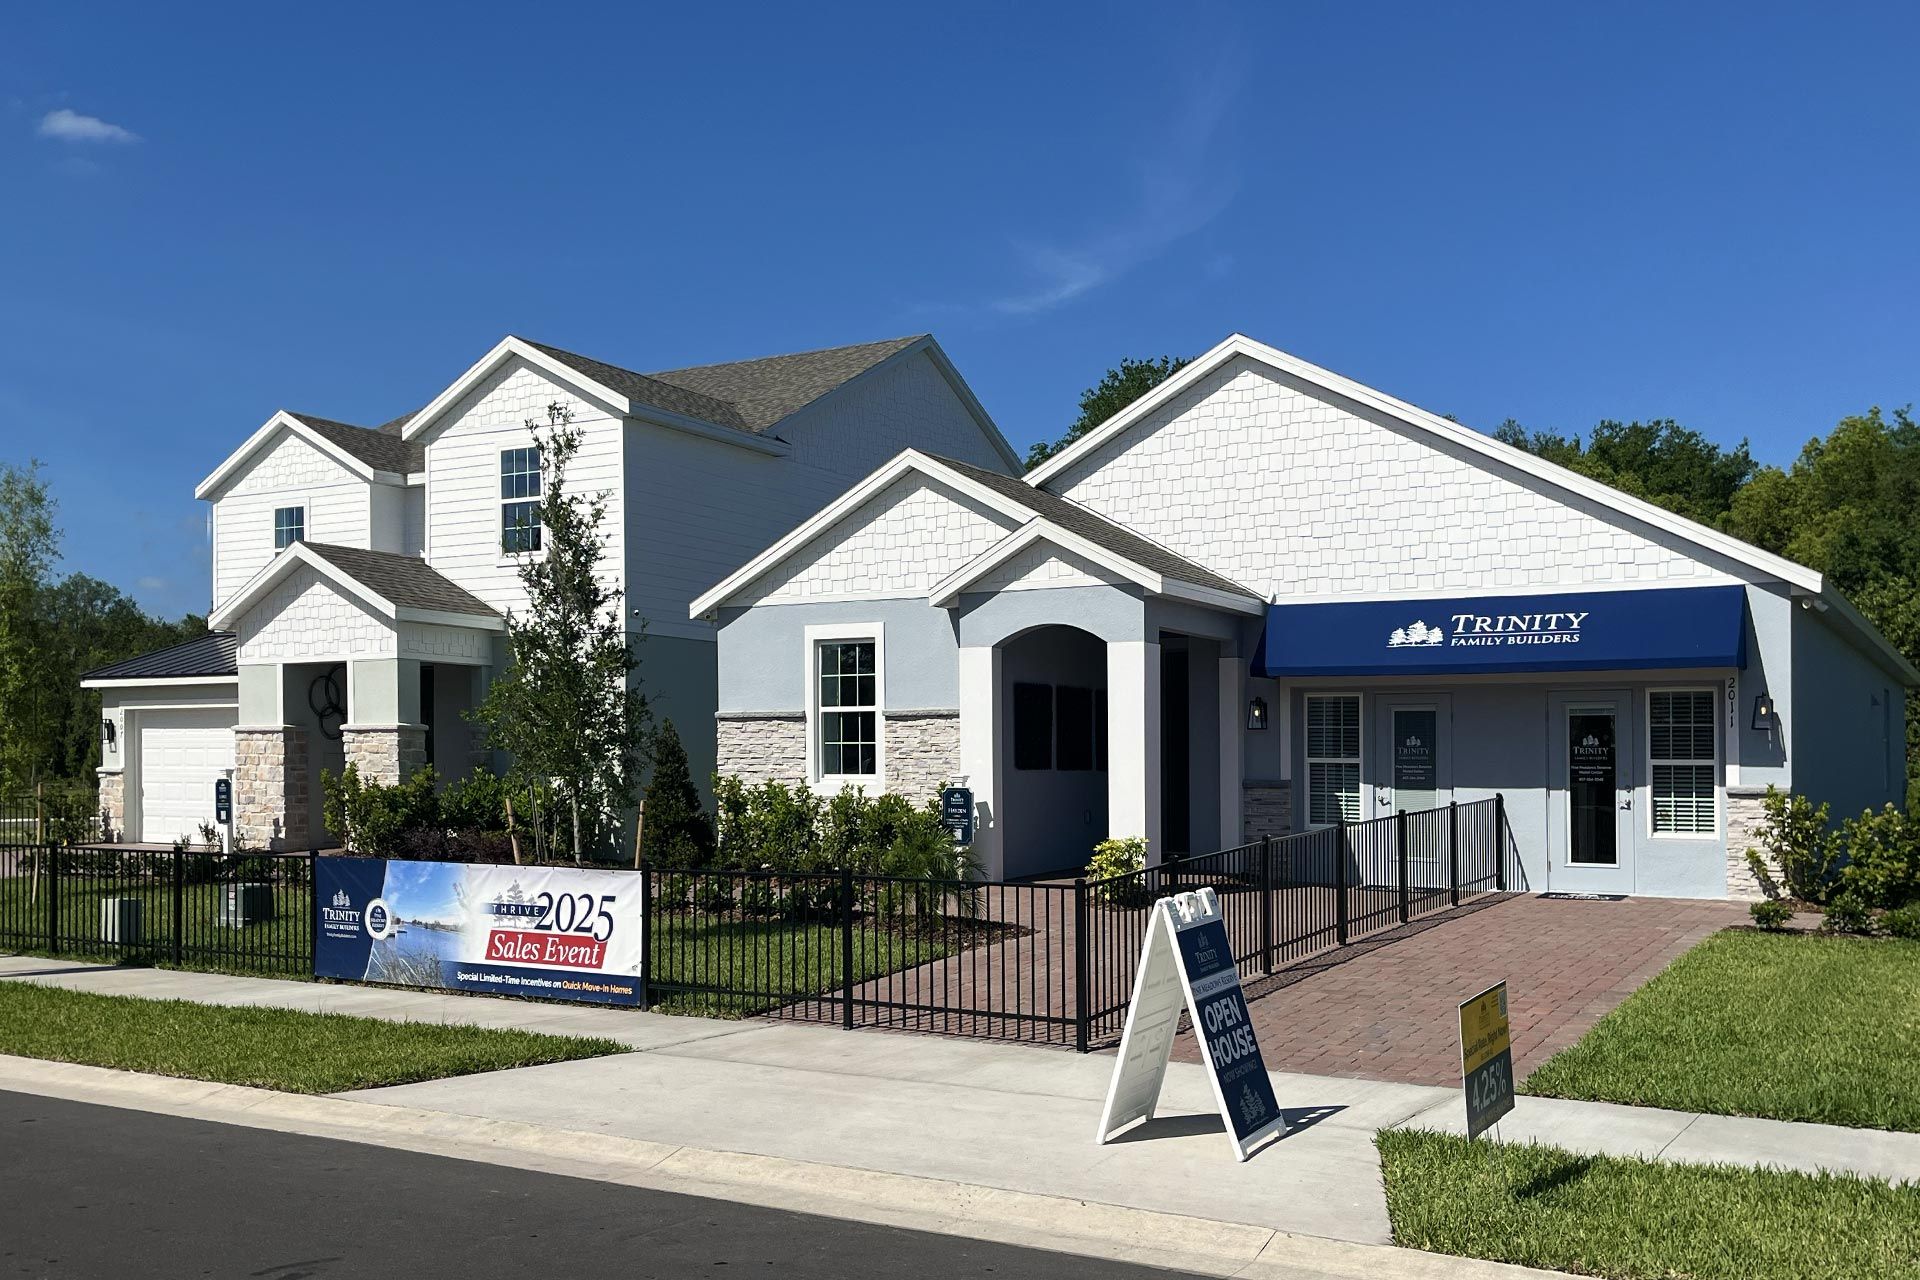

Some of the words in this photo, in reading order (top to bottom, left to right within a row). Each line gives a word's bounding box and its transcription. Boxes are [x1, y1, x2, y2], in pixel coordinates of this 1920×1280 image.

[1451, 612, 1589, 633] TRINITY
[1450, 636, 1503, 647] FAMILY
[1507, 633, 1580, 645] BUILDERS
[1728, 677, 1736, 729] 2011
[1572, 746, 1608, 755] TRINITY
[322, 907, 360, 922] TRINITY
[492, 904, 540, 916] THRIVE
[534, 891, 617, 942] 2025
[491, 933, 541, 961] Sales
[543, 937, 601, 966] Event
[456, 971, 479, 982] Special
[480, 972, 520, 985] Limited-Time
[520, 976, 552, 988] Incentives
[552, 980, 561, 989] on
[562, 980, 581, 990] Quick
[610, 984, 633, 995] Homes
[1204, 994, 1243, 1034] OPEN
[1208, 1024, 1257, 1070] HOUSE
[1472, 1058, 1507, 1113] 4.25%
